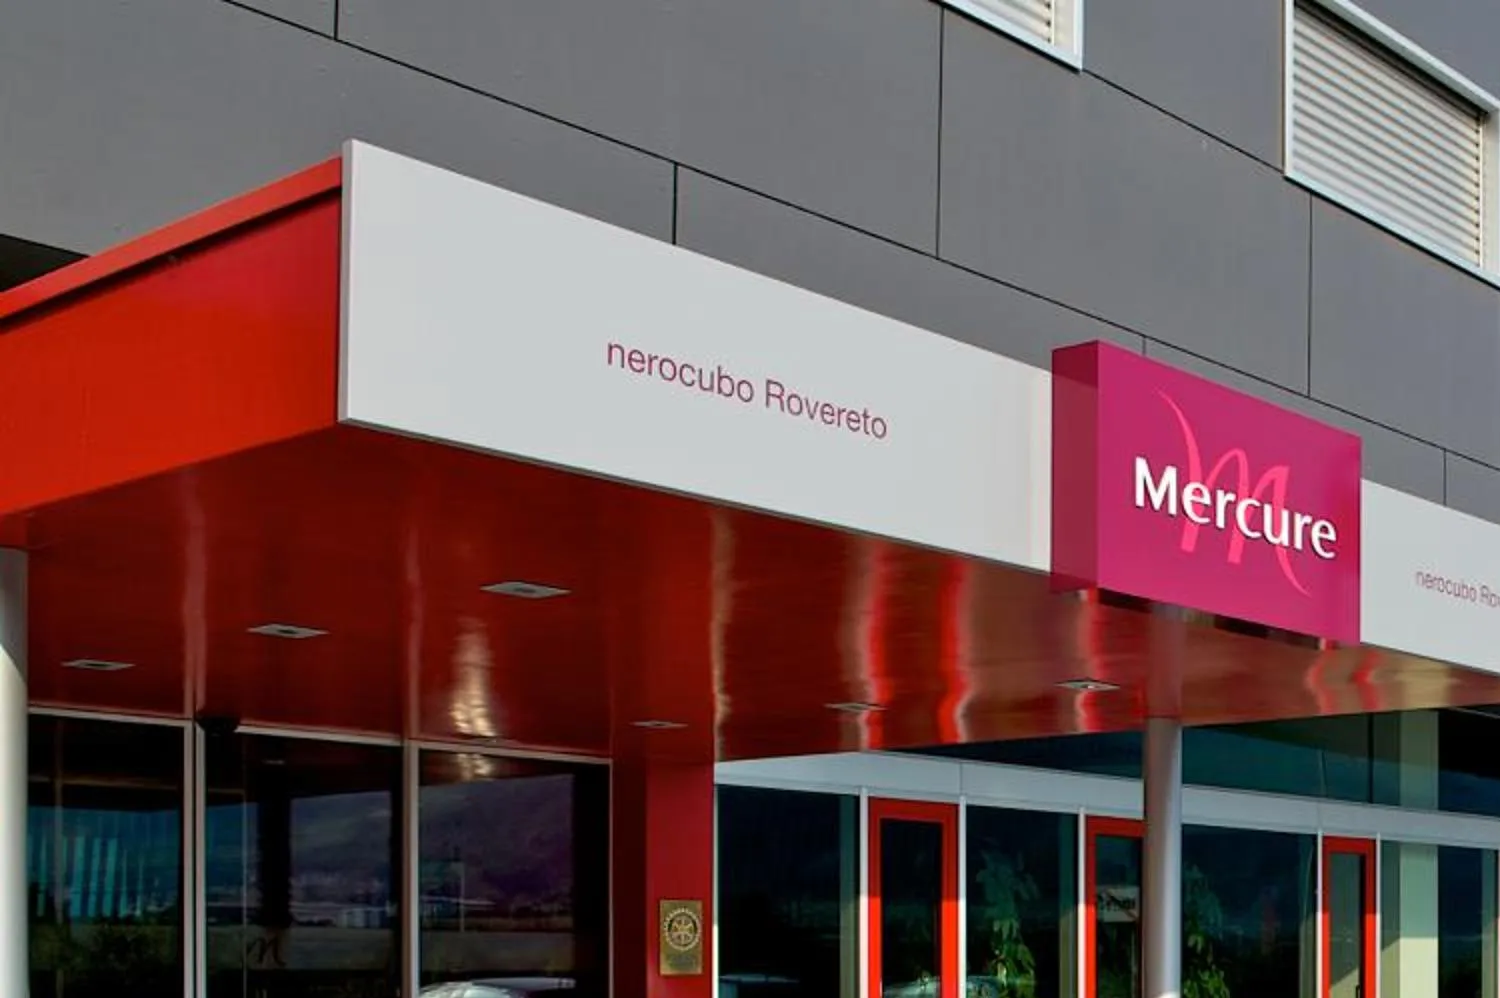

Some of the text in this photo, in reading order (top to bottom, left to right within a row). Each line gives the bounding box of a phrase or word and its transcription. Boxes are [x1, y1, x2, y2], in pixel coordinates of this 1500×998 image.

[606, 342, 888, 440] nerocubo Rovereto
[1134, 454, 1338, 560] Mercure
